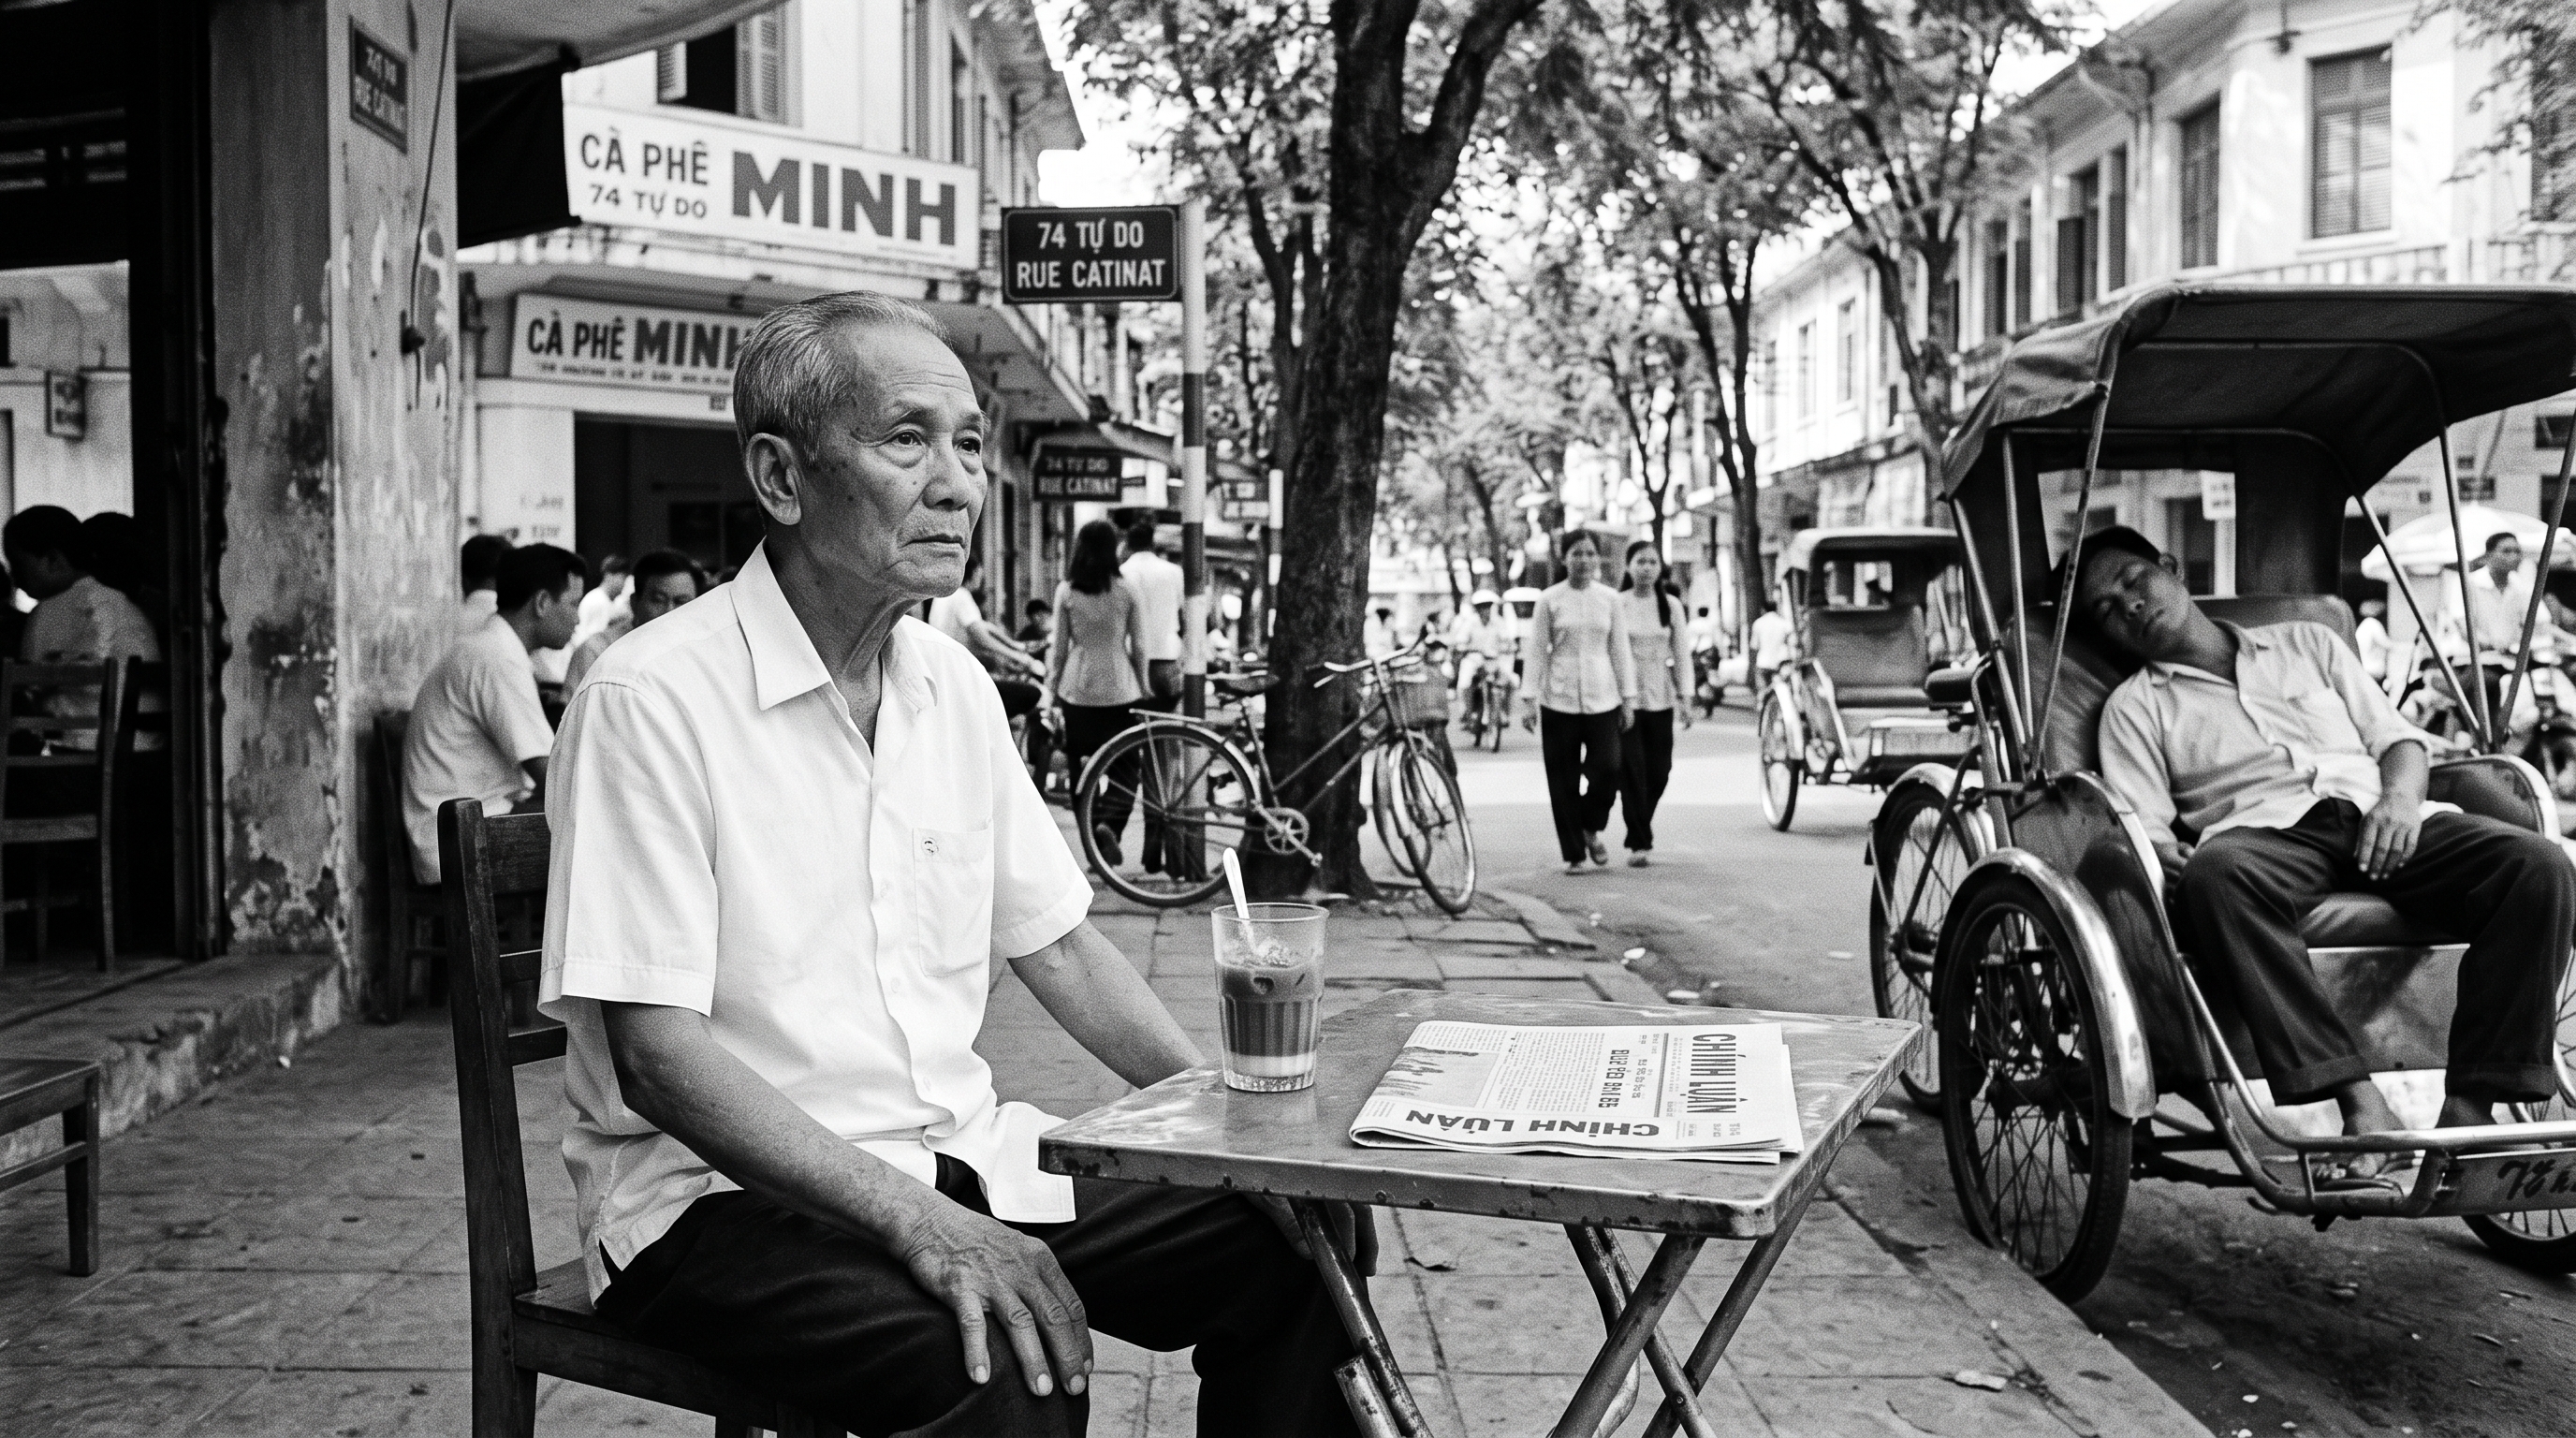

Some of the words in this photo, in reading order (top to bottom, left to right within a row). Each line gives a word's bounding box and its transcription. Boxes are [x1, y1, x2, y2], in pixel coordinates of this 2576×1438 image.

[579, 126, 625, 173] CÀ
[642, 139, 708, 185] PHÊ
[732, 150, 956, 247] MINH
[590, 183, 621, 205] 74
[673, 197, 708, 219] DO
[1036, 220, 1067, 250] 74
[1113, 220, 1145, 249] DO
[1016, 259, 1062, 289] RUE
[1072, 257, 1167, 288] CATINAT
[573, 315, 624, 361] PHÊ
